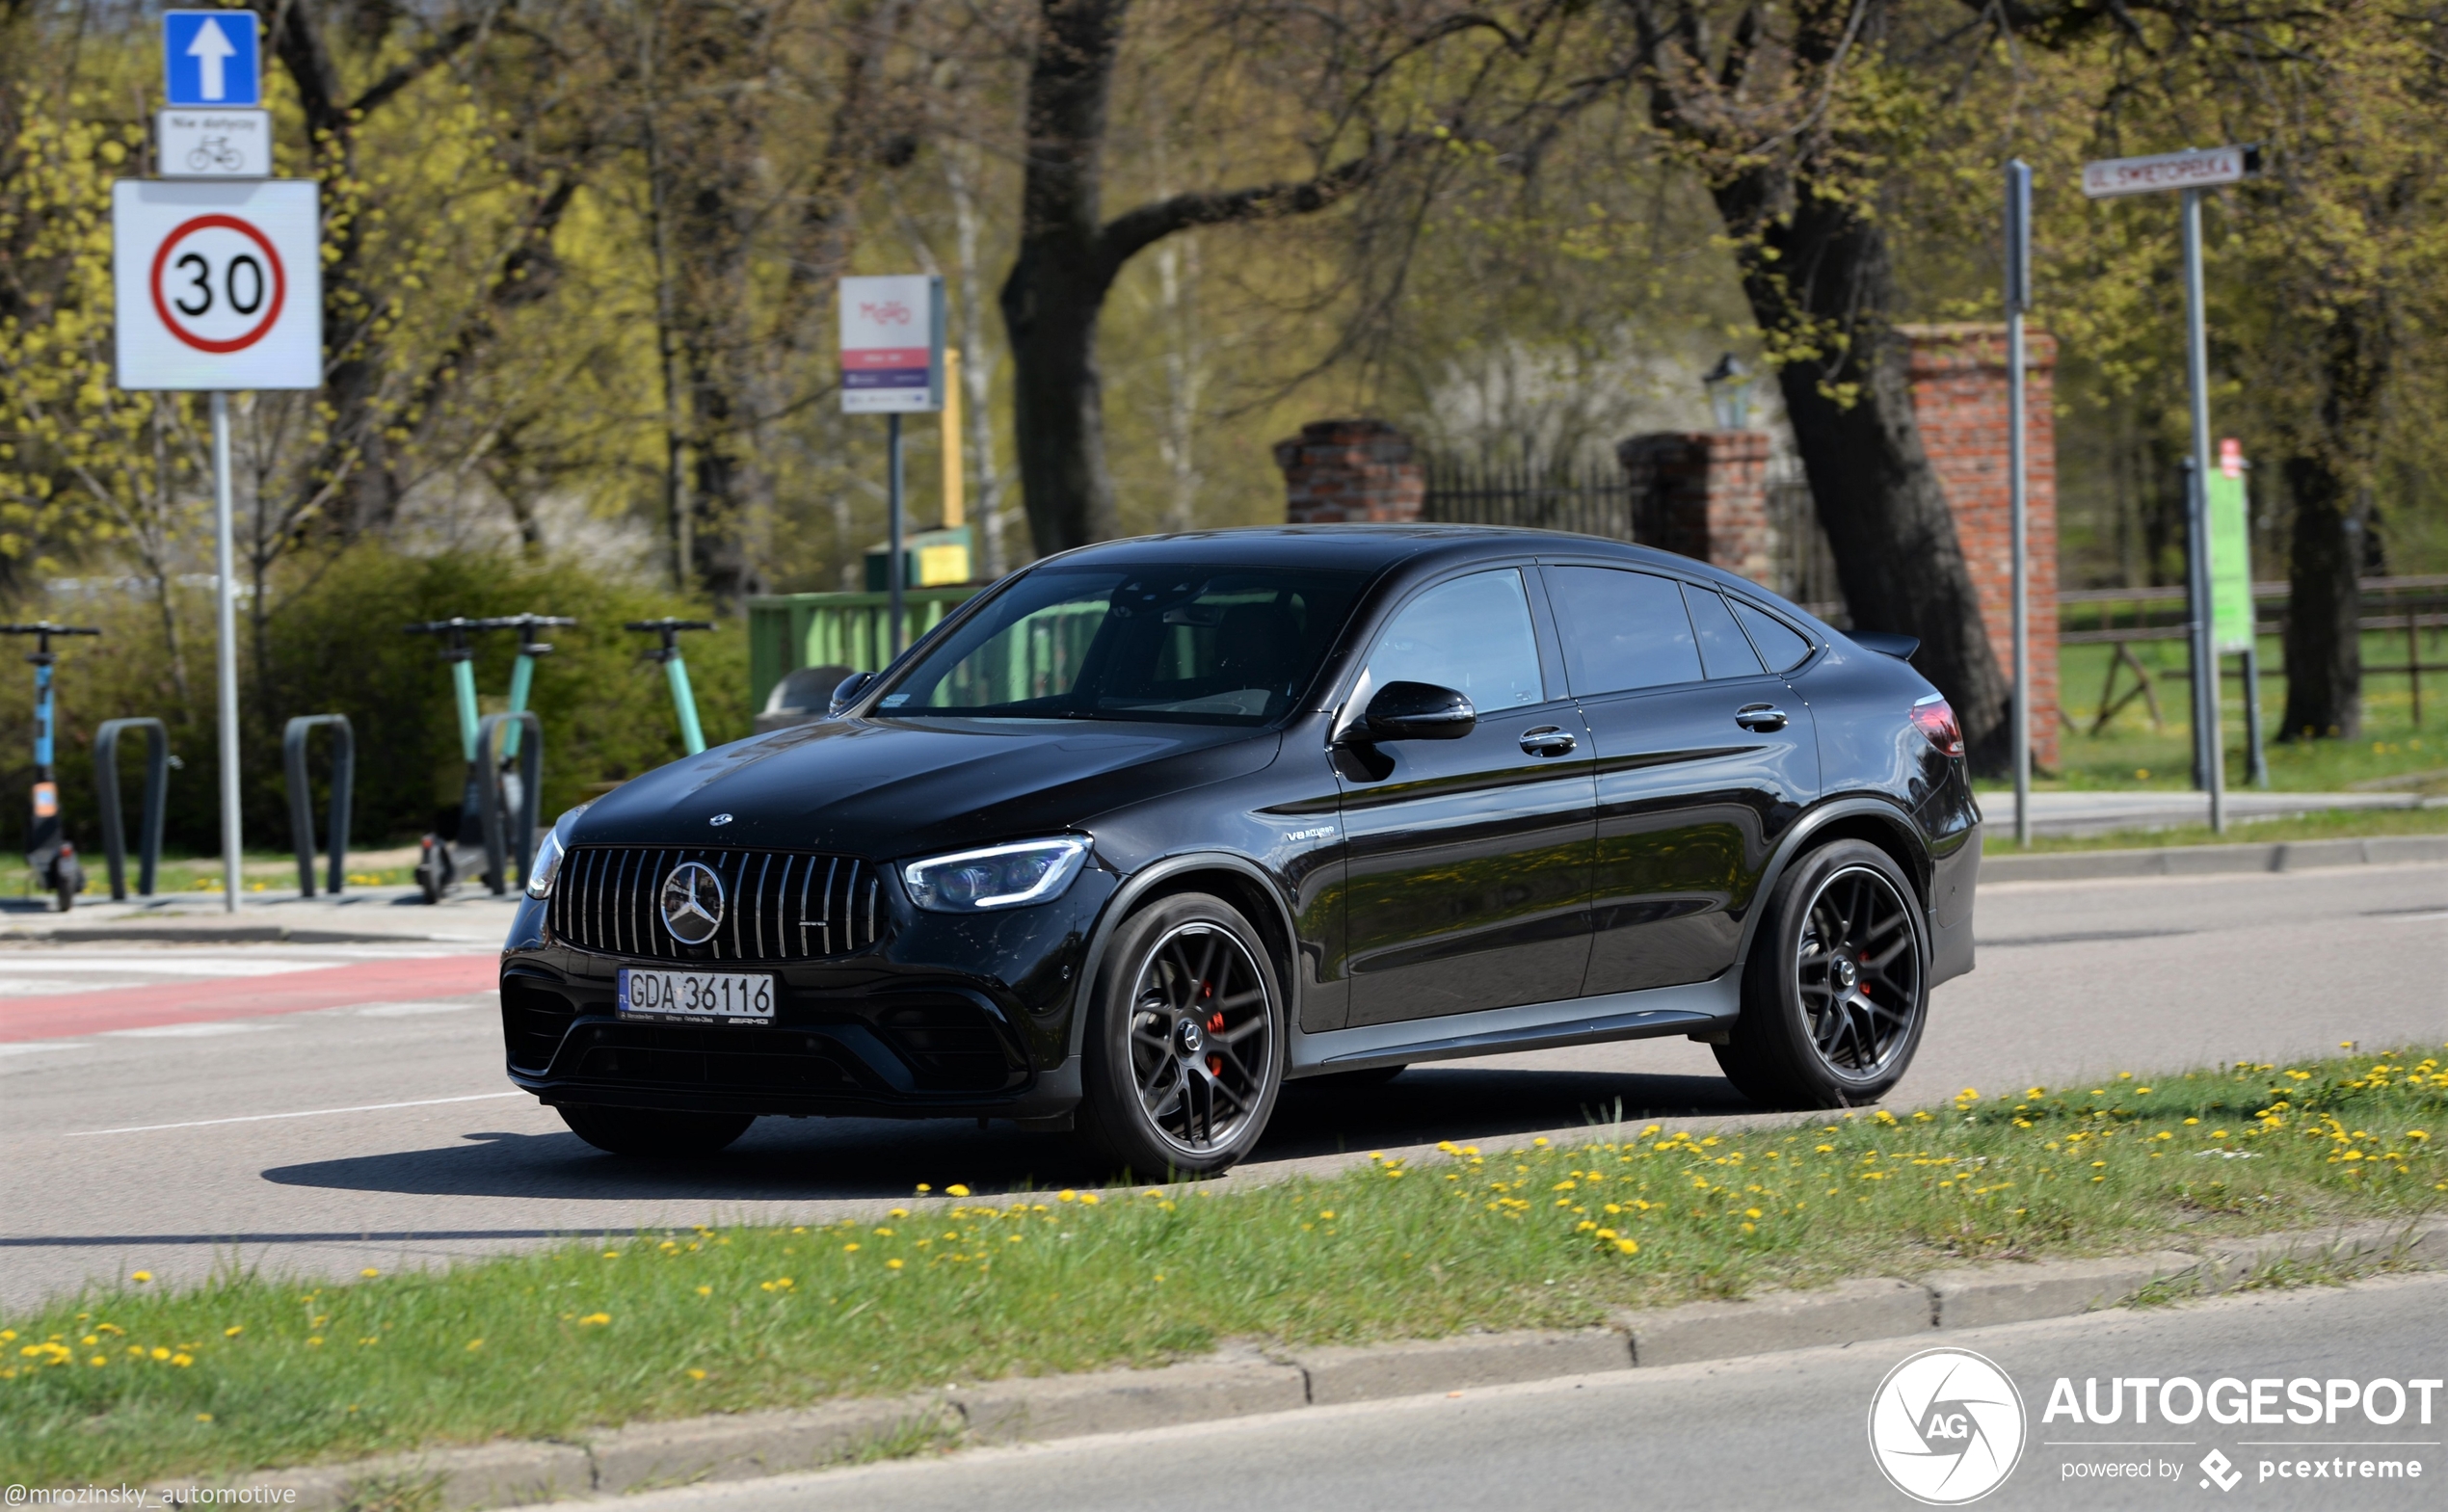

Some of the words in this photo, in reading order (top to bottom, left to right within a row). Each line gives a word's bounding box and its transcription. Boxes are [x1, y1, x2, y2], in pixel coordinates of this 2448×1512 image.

[173, 118, 196, 127] Nie
[174, 252, 264, 316] 30
[630, 973, 678, 1010] GDA
[684, 976, 770, 1014] 36116
